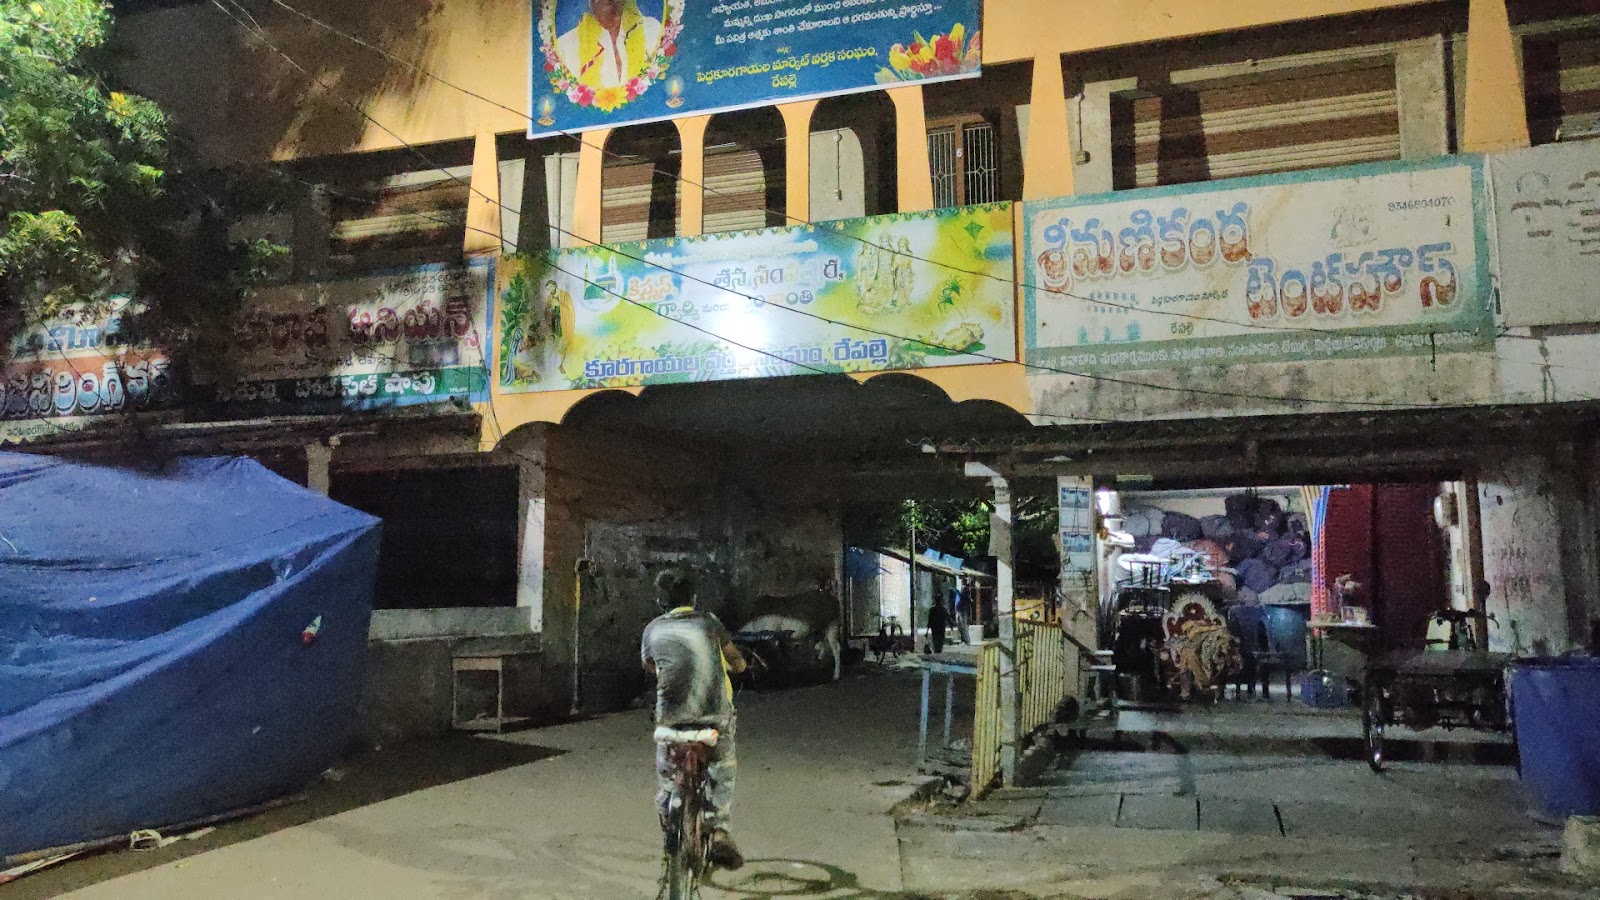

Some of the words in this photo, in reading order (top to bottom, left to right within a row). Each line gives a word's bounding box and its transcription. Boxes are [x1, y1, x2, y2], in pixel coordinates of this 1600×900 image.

[726, 31, 747, 44] పవిత్ర
[771, 74, 798, 89] రేపల్లె
[584, 354, 700, 378] కూరగాయల
[833, 337, 888, 364] రేపల్లె
